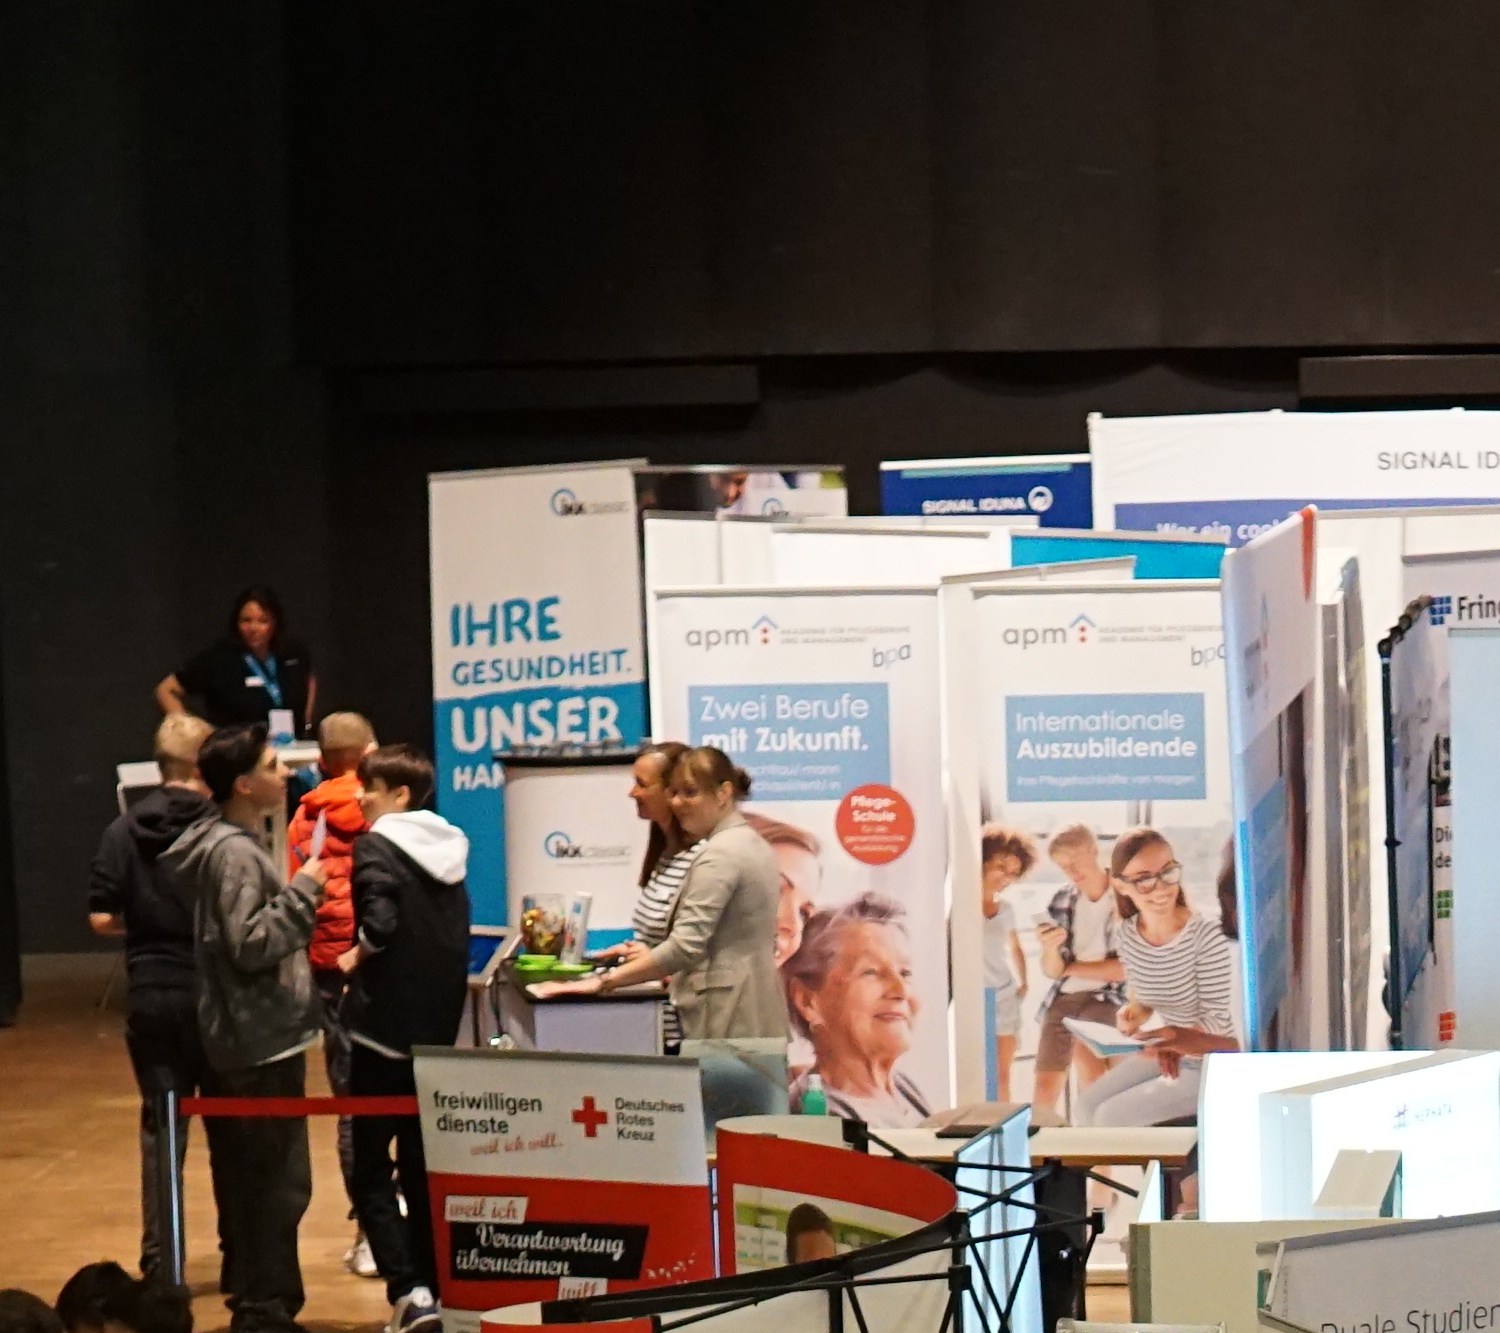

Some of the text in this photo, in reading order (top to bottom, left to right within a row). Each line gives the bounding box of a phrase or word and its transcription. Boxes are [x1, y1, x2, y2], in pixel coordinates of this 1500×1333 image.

[1377, 451, 1468, 471] SIGNAL
[450, 596, 562, 647] IHRE
[685, 628, 748, 651] apm
[1002, 625, 1067, 649] apm
[451, 648, 632, 686] GESUNDHEIT.
[700, 693, 870, 722] Zwei Berufe
[450, 695, 623, 753] UNSER
[1016, 709, 1185, 733] Internationale
[701, 725, 869, 753] mit Zukunft.
[1016, 737, 1197, 760] Auszubildende
[433, 1090, 542, 1116] freiwilligen
[615, 1097, 685, 1113] Deutsches
[437, 1116, 509, 1134] dienste
[616, 1113, 655, 1126] Rotes
[617, 1128, 655, 1141] Kreuz
[476, 1222, 625, 1262] Verantwortung
[456, 1249, 570, 1275] übernehmen
